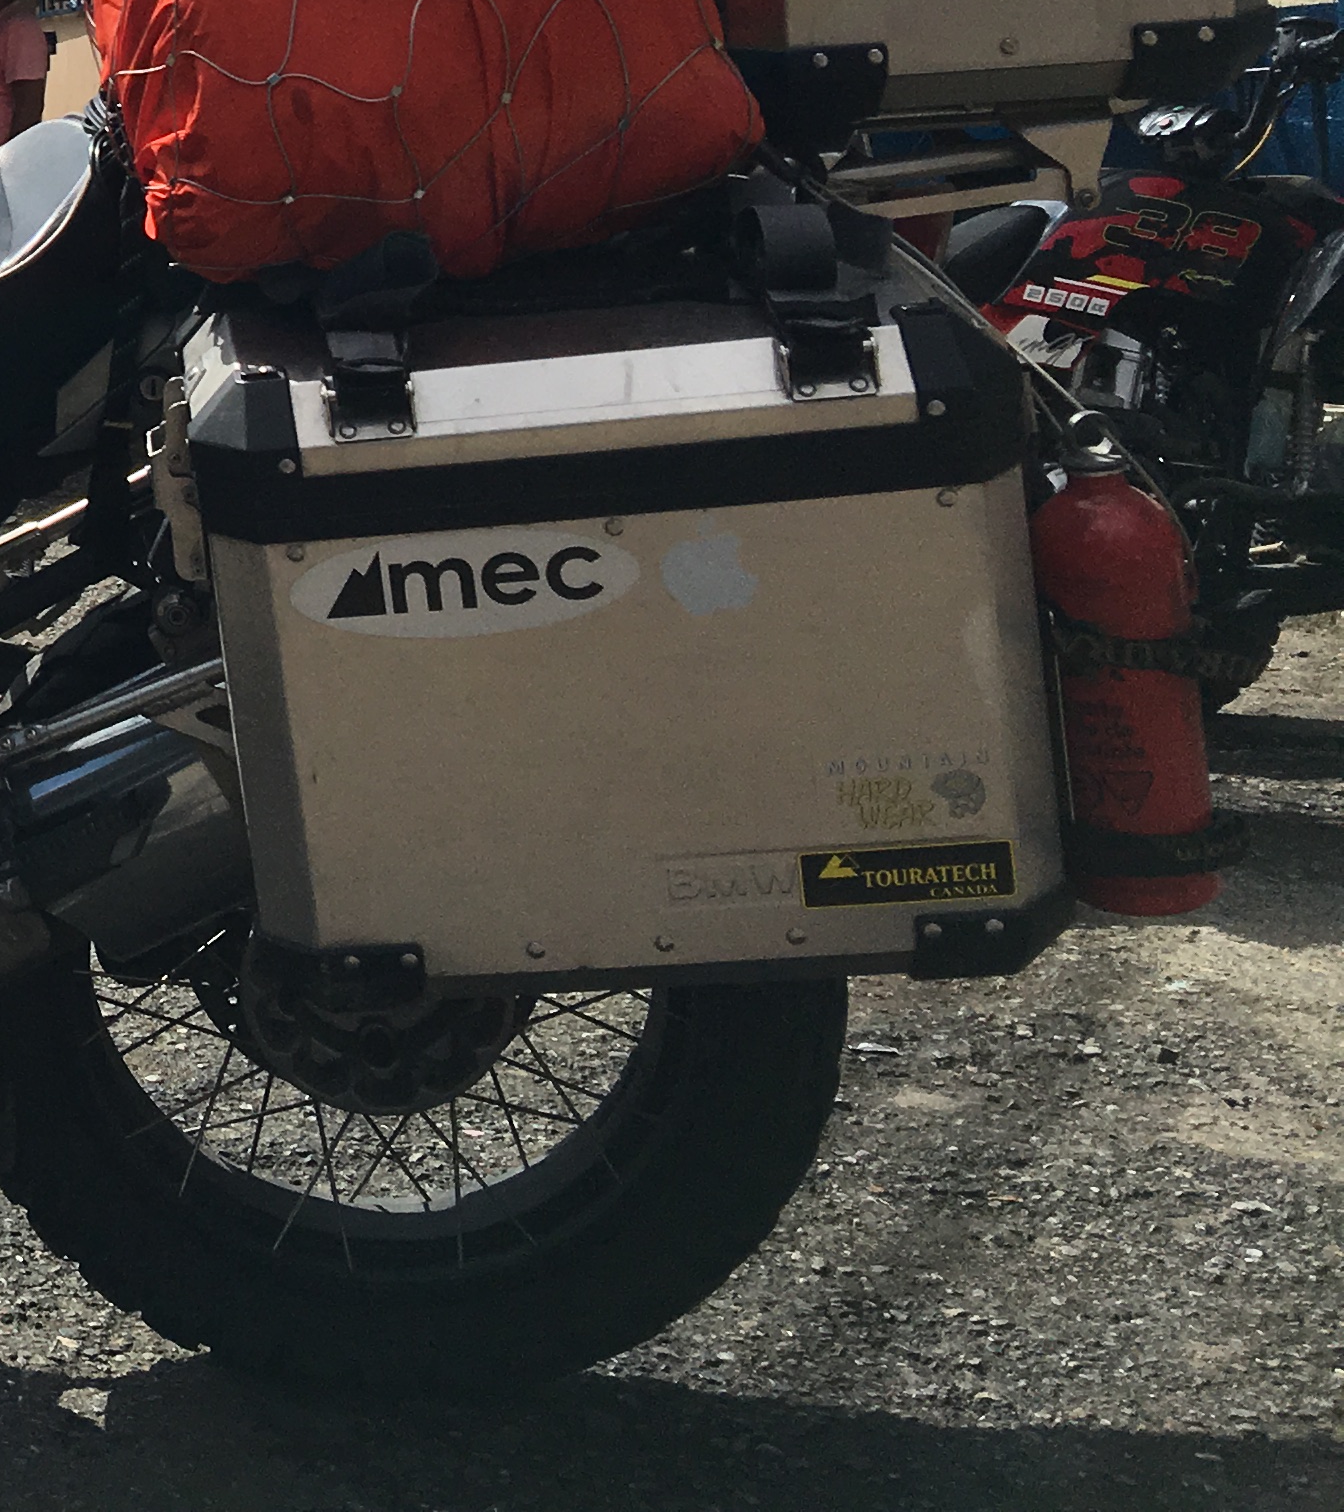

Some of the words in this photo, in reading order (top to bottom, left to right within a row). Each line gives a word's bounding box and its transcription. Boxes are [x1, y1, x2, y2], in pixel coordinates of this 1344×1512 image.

[387, 545, 605, 615] mec
[863, 861, 998, 889] TOURATECH
[929, 883, 1000, 898] CANADA
